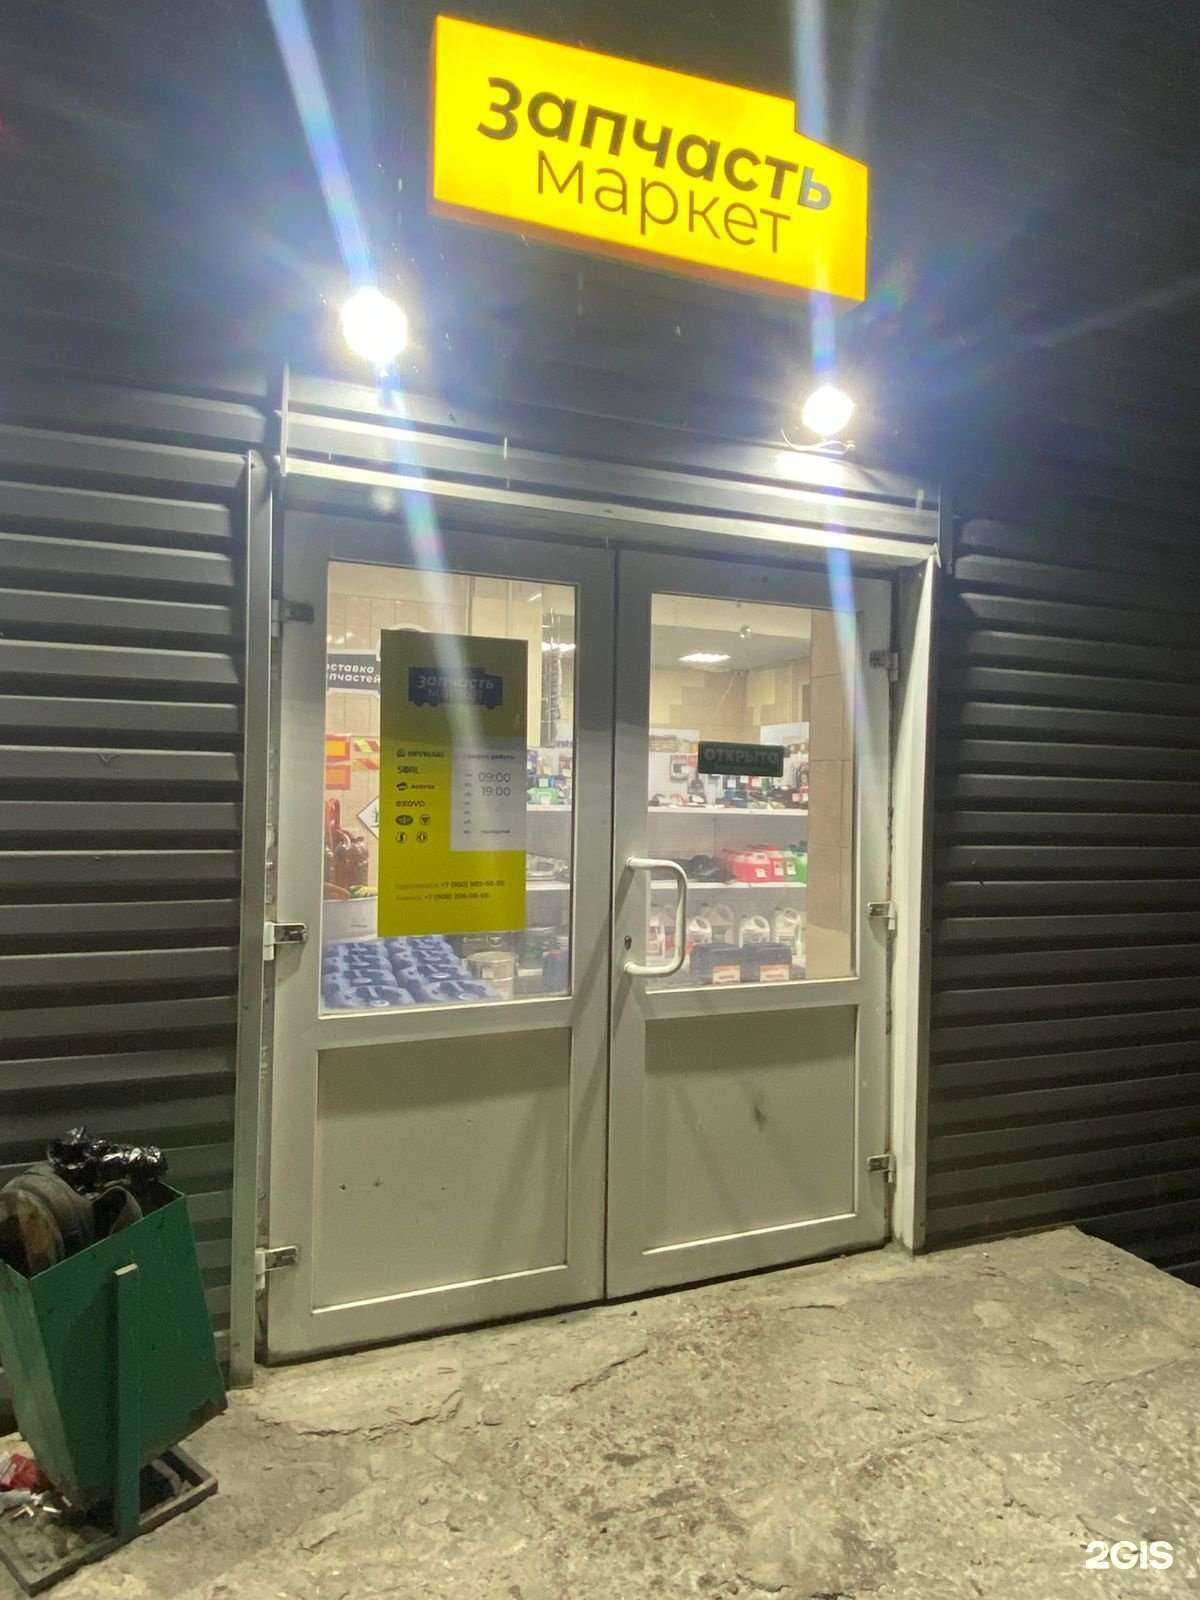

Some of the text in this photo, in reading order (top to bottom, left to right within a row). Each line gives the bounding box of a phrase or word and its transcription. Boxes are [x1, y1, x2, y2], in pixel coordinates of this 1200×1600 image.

[477, 77, 831, 211] Запчасть
[326, 673, 380, 684] пчастей
[416, 674, 495, 689] Запасть
